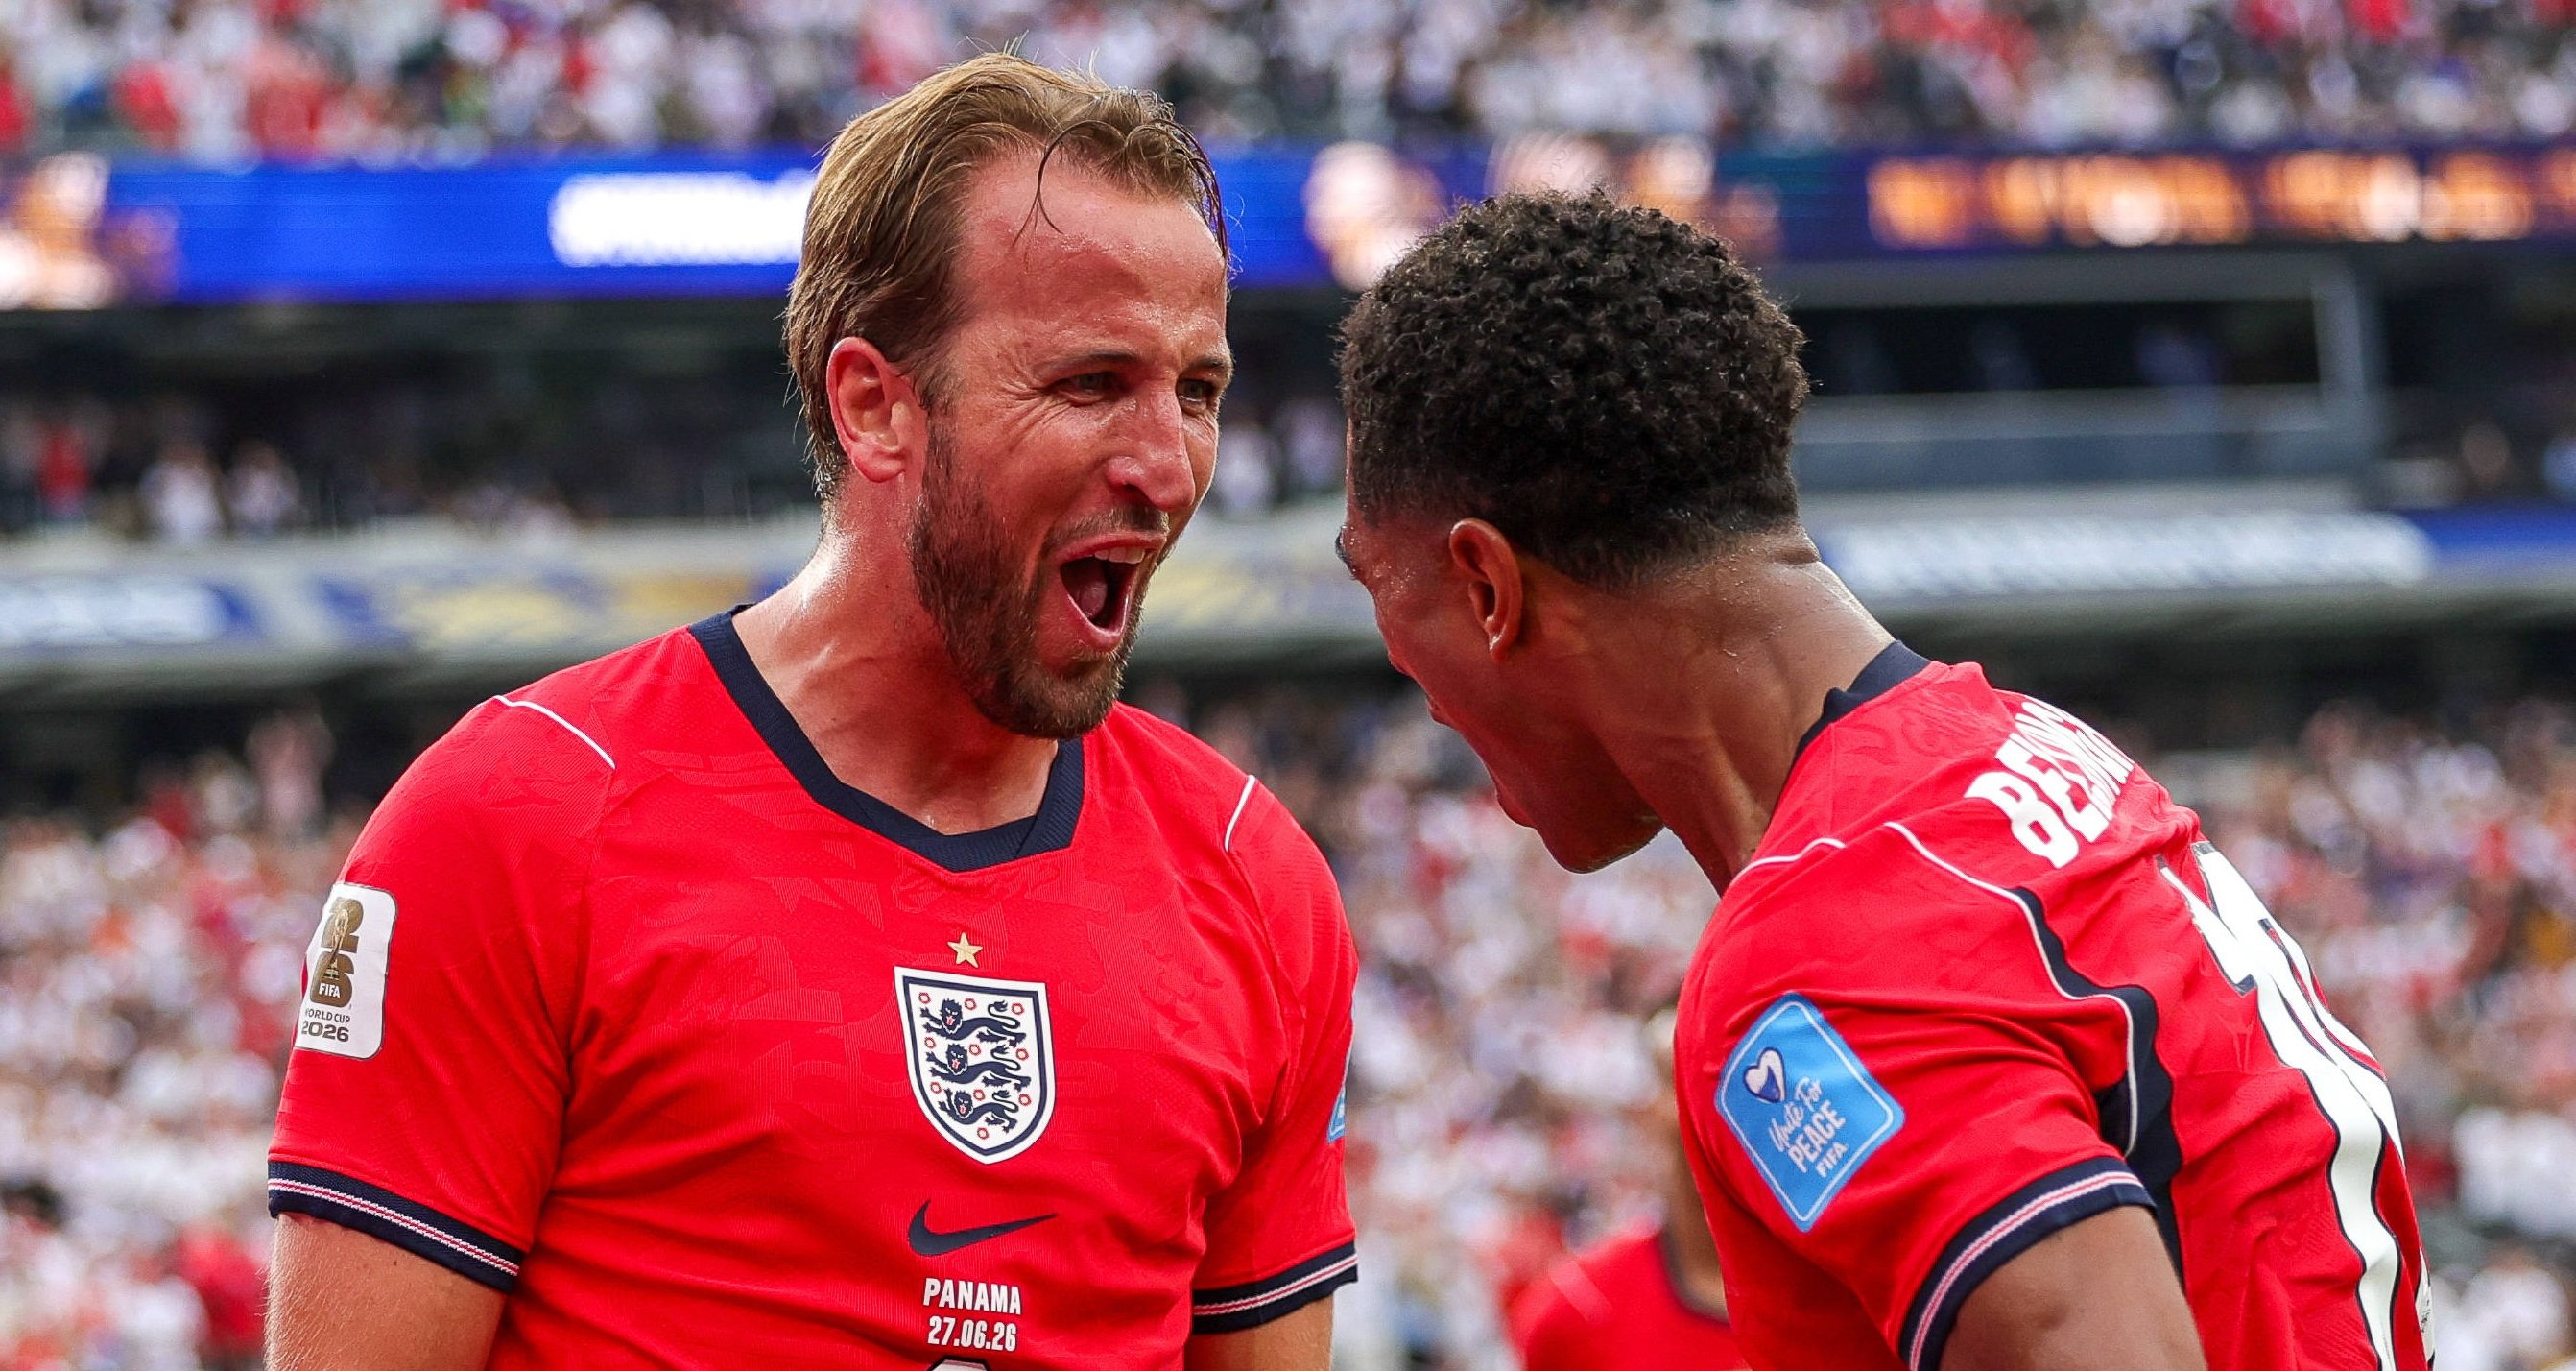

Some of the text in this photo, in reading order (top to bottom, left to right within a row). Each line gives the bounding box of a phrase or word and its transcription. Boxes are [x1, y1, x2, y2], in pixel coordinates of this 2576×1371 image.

[318, 982, 341, 998] FIFA
[301, 1020, 349, 1043] 2026
[334, 1013, 351, 1024] CUP
[1768, 1076, 1823, 1152] Unite For
[1788, 1099, 1846, 1173] PEACE
[1815, 1142, 1849, 1178] FIFA
[922, 1277, 1022, 1315] PANAMA
[927, 1315, 1017, 1352] 27.06.26
